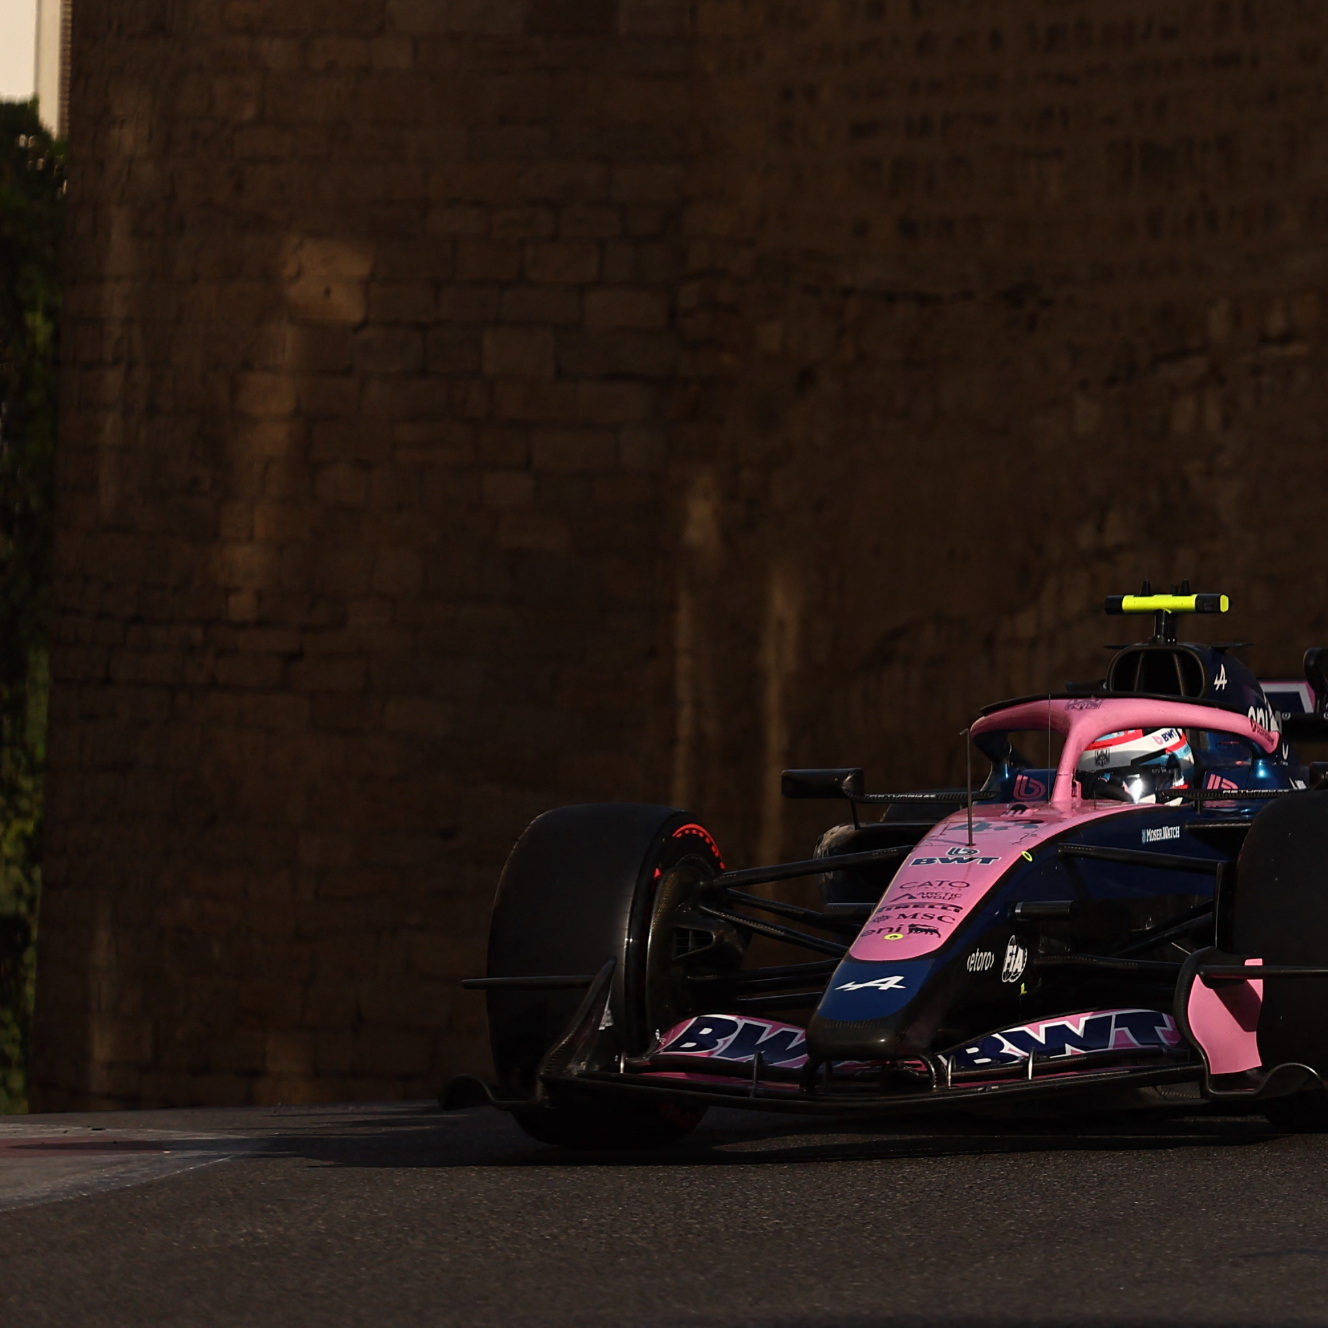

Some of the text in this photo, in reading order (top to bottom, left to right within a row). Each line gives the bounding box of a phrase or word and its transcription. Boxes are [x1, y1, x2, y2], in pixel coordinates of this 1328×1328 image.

[911, 856, 1001, 867] BWT
[899, 879, 971, 889] CATO
[896, 912, 956, 925] MSC
[860, 923, 905, 938] eni
[938, 1009, 1176, 1070] BWT
